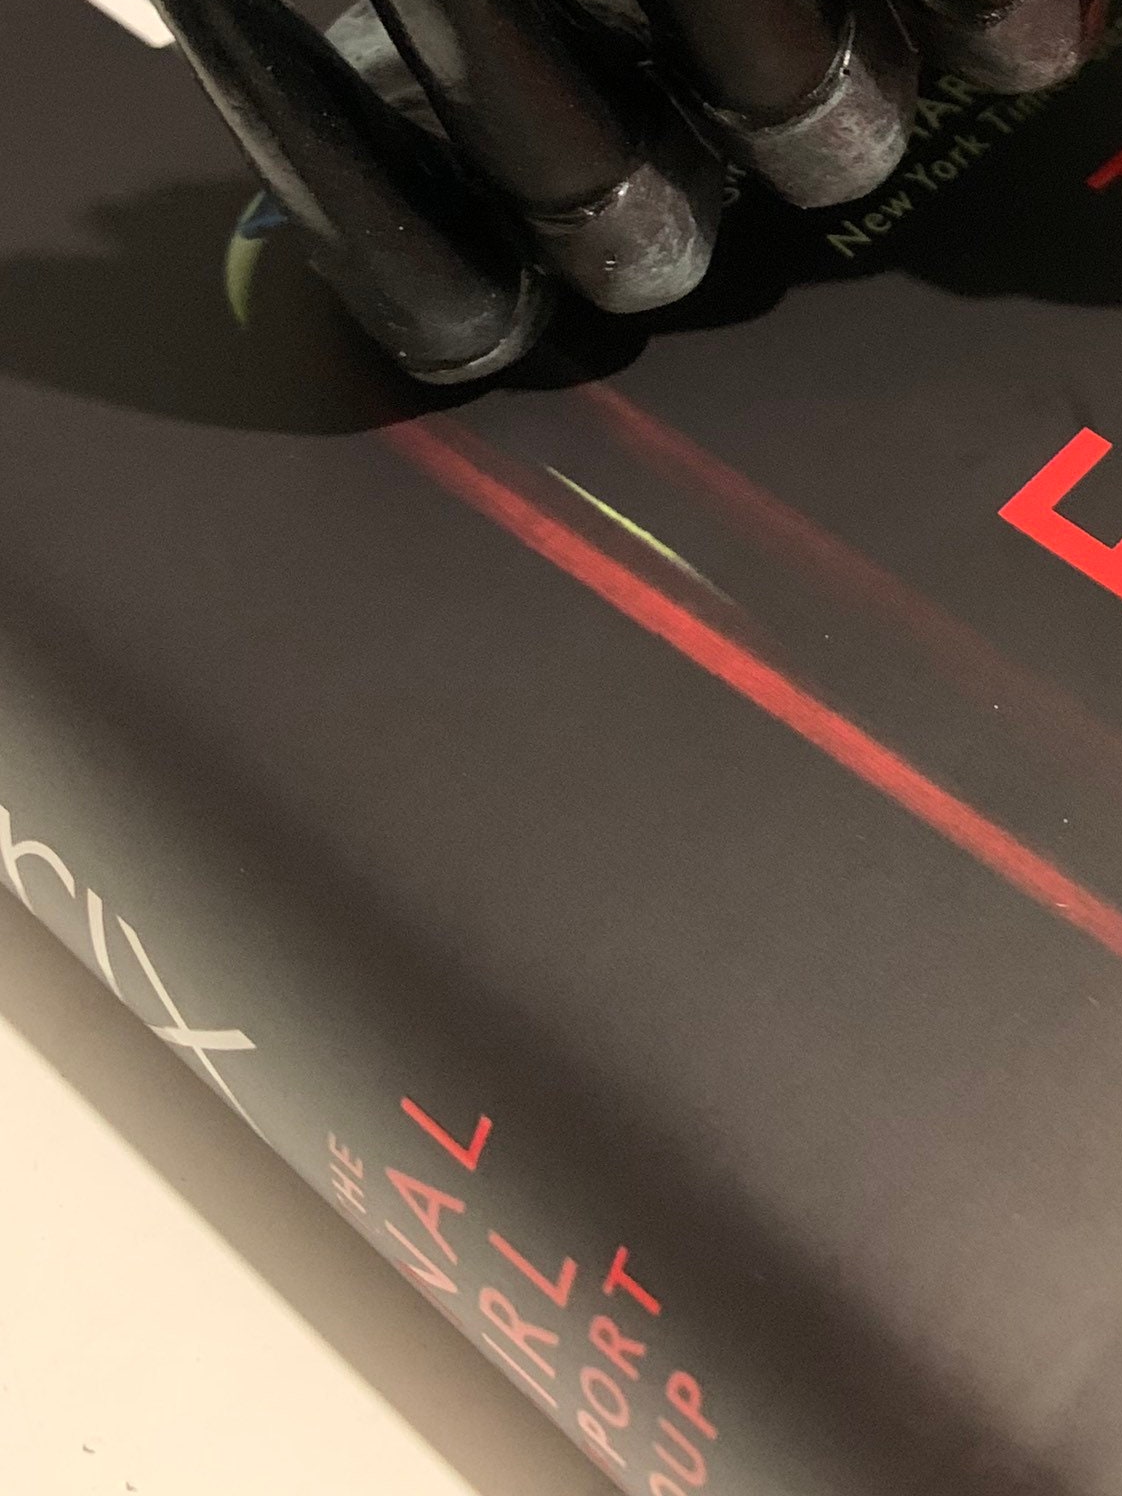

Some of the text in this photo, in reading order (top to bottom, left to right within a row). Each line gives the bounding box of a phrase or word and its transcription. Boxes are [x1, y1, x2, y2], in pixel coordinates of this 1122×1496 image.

[826, 188, 915, 259] New
[903, 132, 992, 194] York
[326, 1130, 370, 1231] HE
